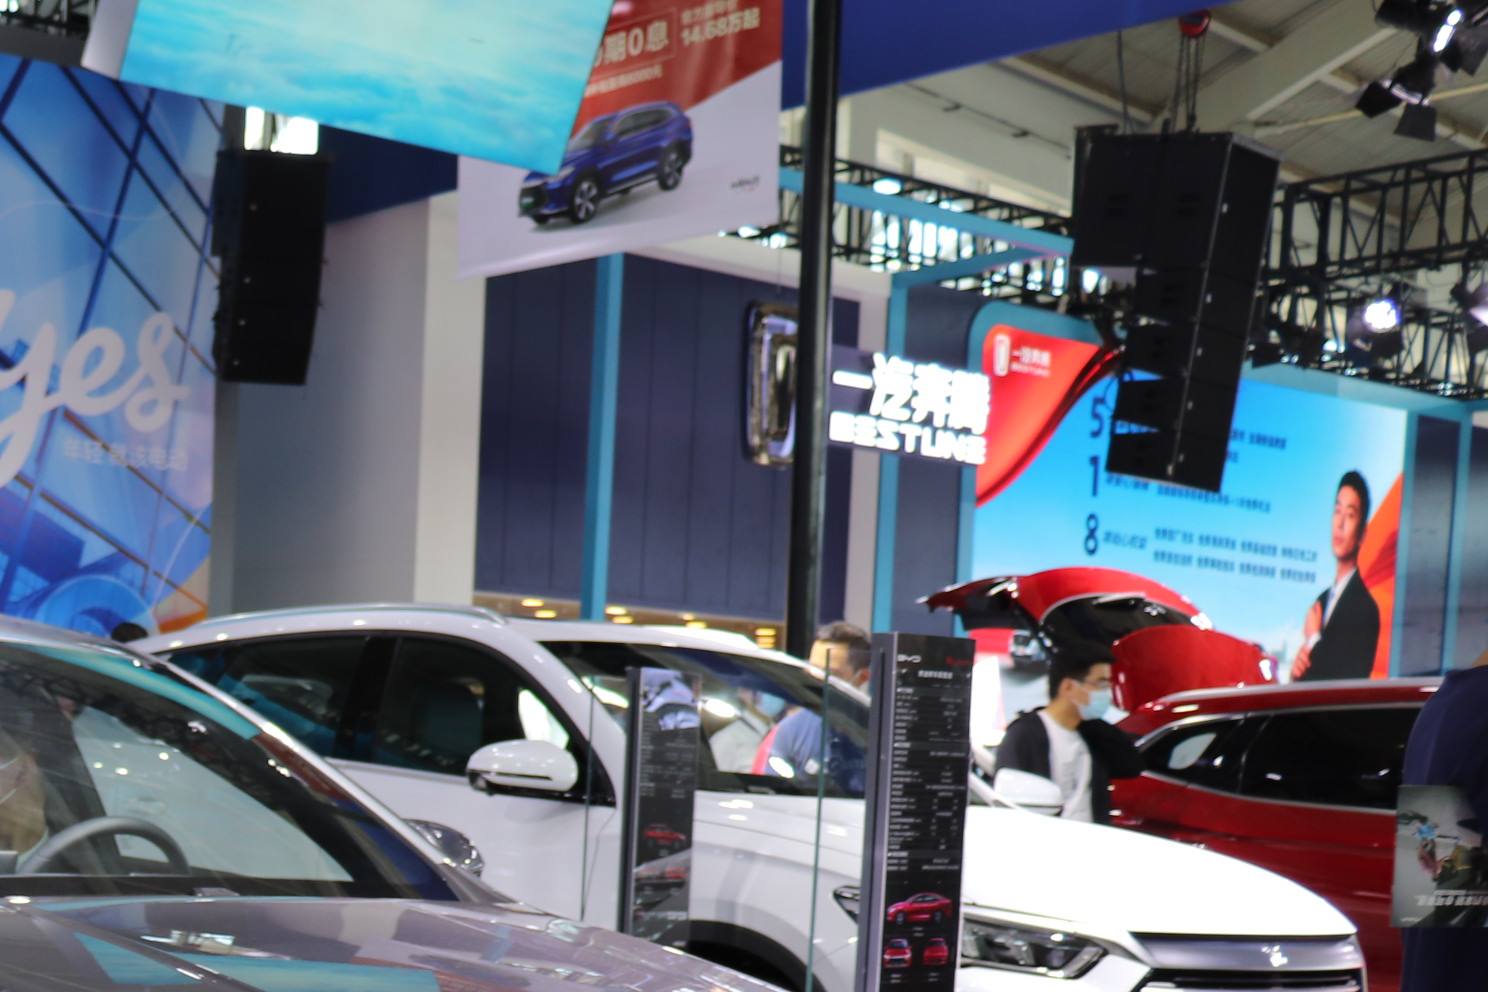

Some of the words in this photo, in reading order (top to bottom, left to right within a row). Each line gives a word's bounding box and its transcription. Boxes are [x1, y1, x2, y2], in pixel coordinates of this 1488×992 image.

[829, 410, 987, 465] BESTUNE
[1089, 397, 1105, 438] 5
[1088, 455, 1101, 497] 1
[1083, 512, 1100, 556] 8
